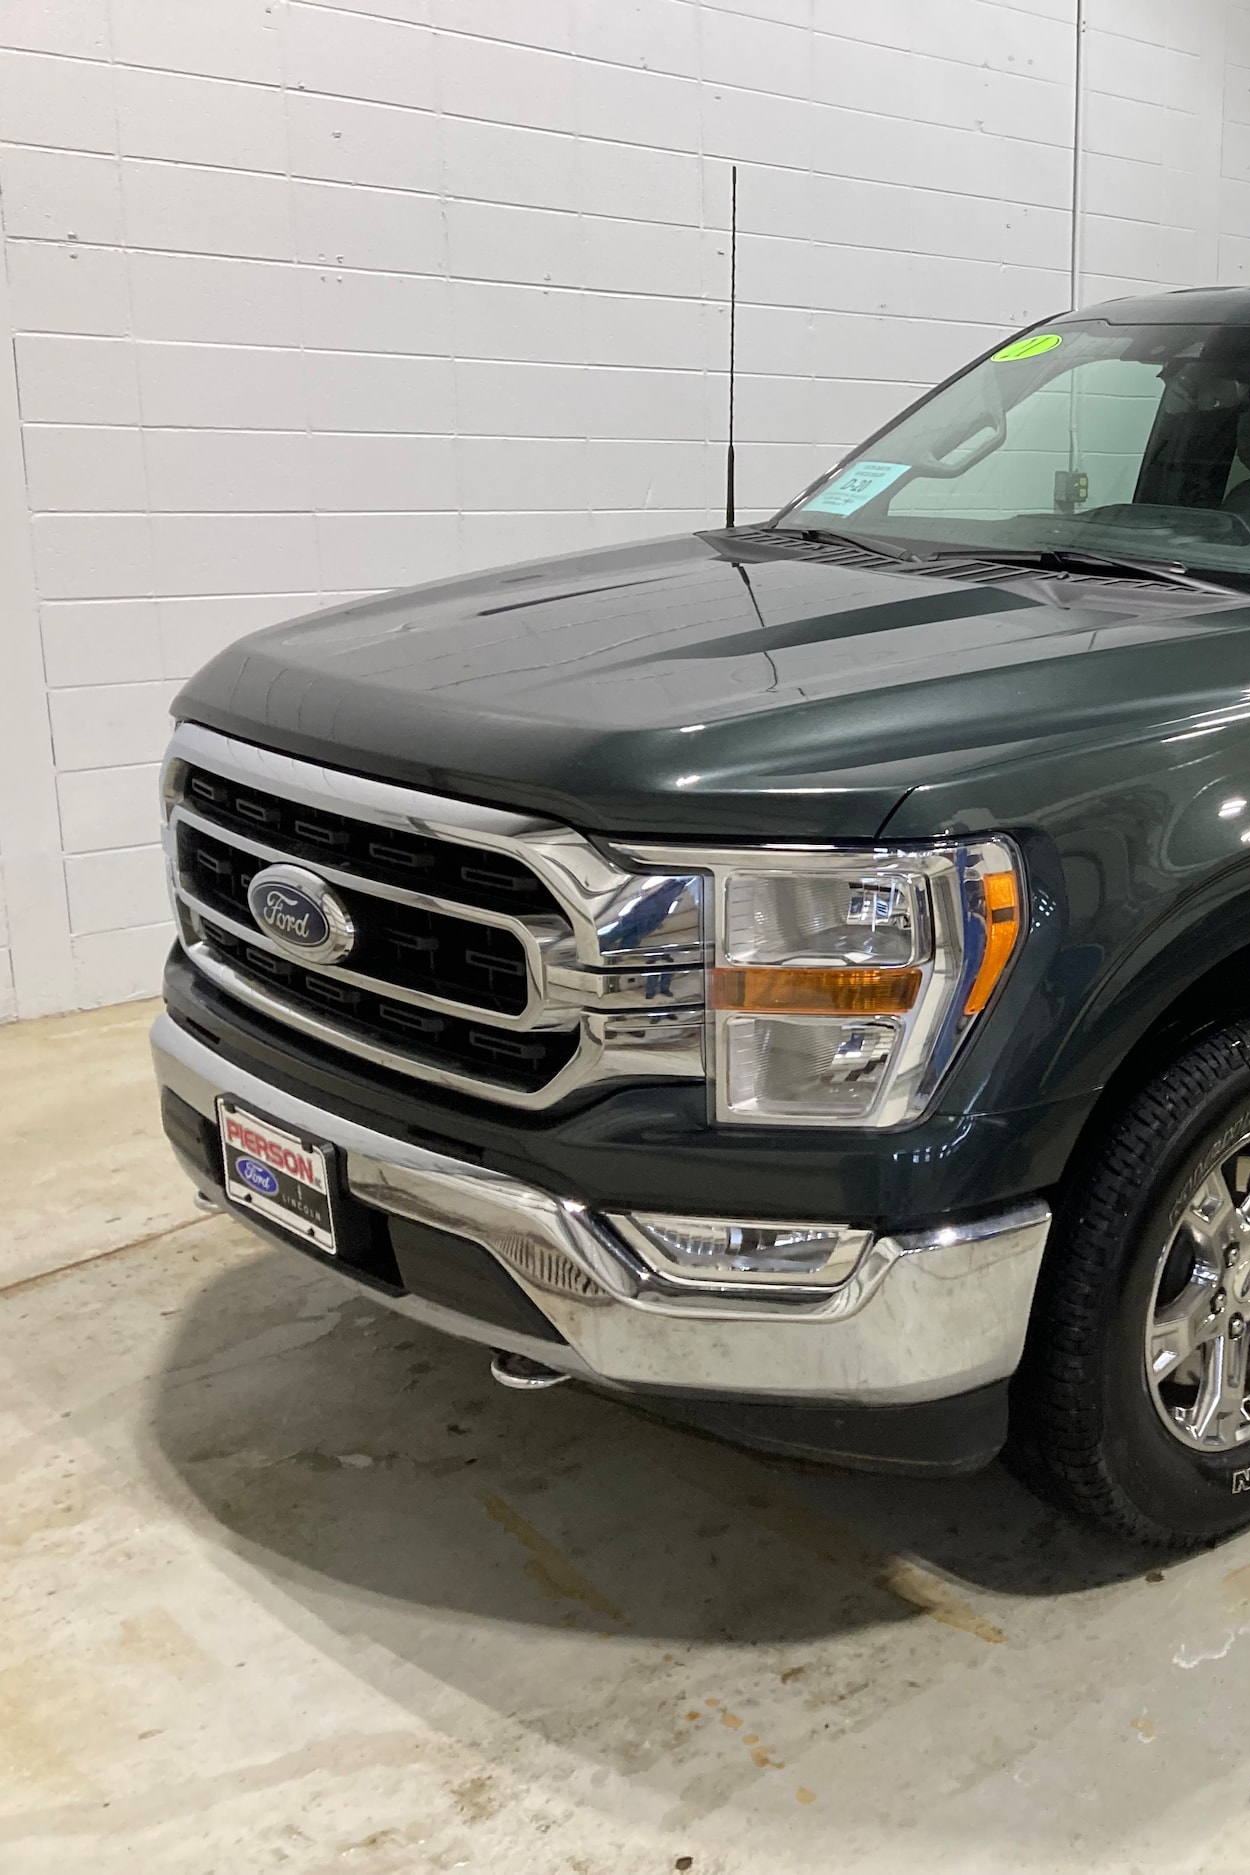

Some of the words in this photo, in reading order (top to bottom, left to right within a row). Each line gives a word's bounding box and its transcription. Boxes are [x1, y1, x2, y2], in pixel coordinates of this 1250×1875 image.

[263, 890, 310, 938] Ford
[226, 1119, 314, 1184] PIERSON
[243, 1160, 271, 1190] Ford
[282, 1194, 321, 1221] LINCOLN
